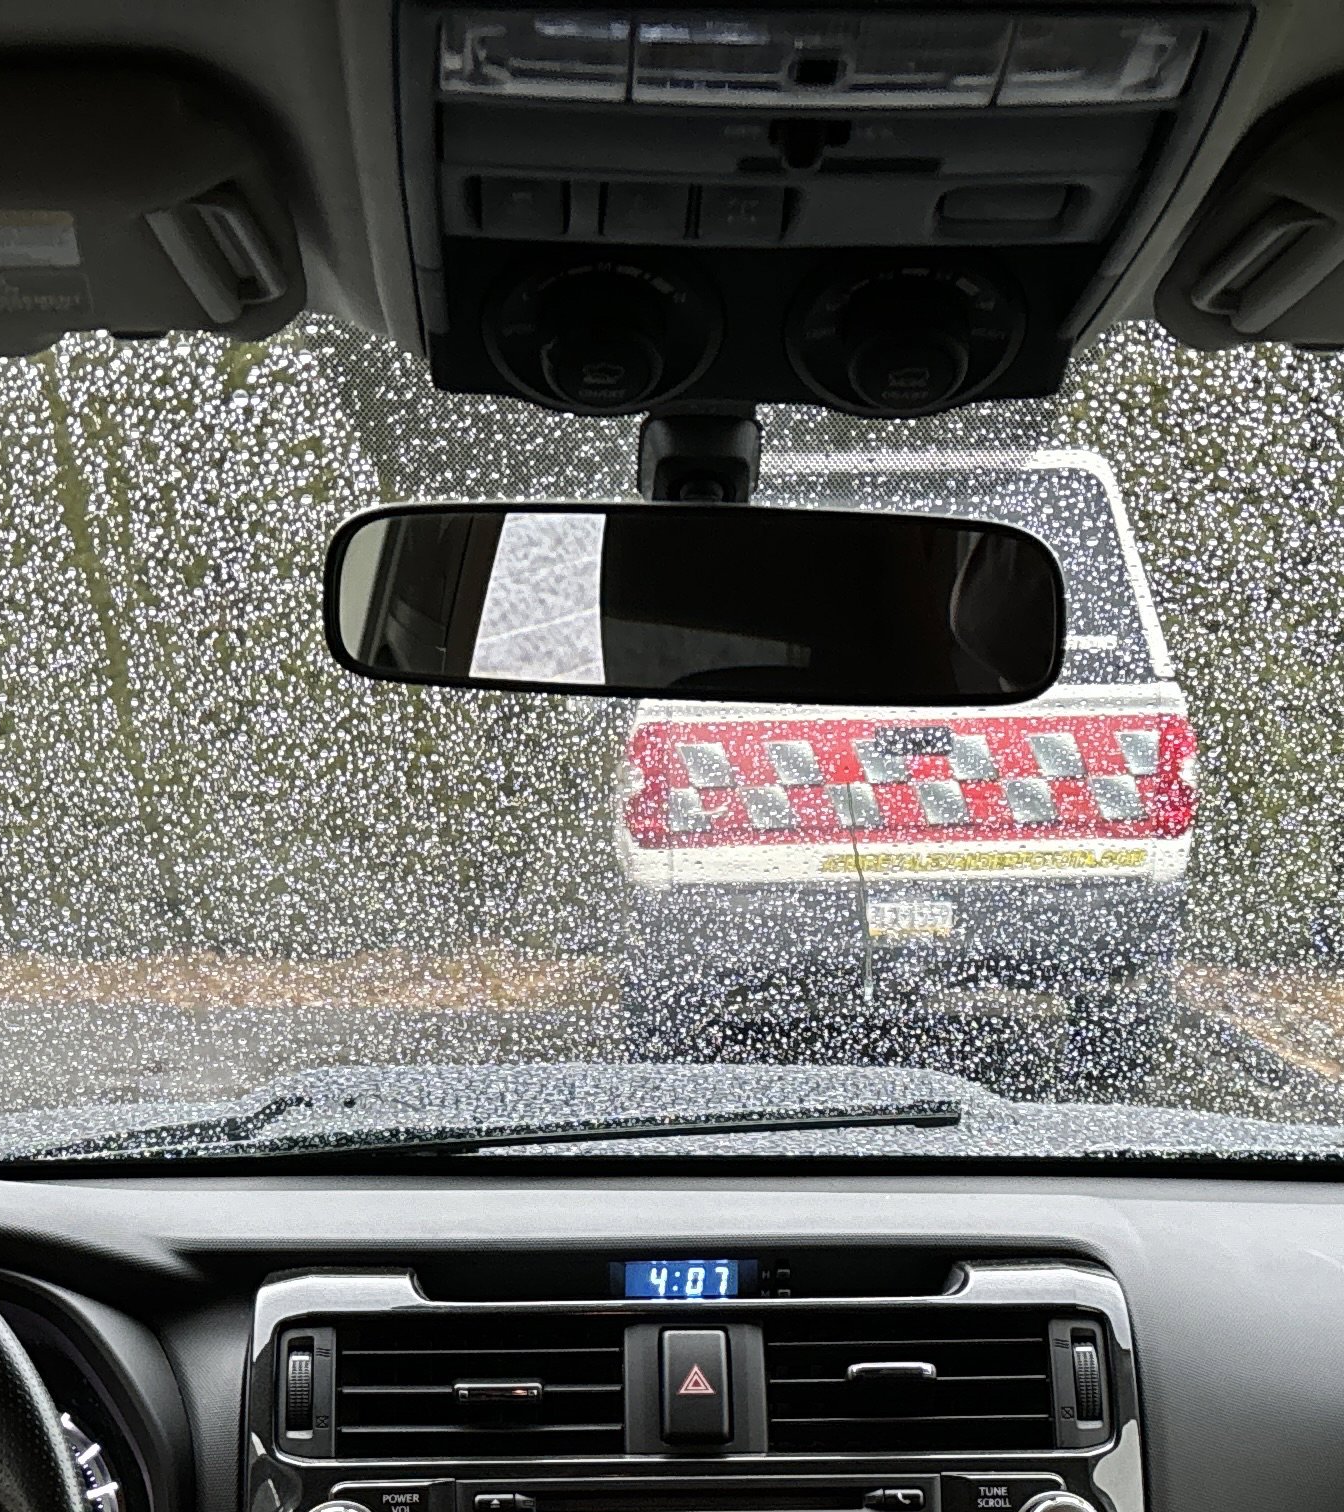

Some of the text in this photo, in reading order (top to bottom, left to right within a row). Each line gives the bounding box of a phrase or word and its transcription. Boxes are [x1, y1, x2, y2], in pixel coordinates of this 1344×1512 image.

[649, 1266, 730, 1296] 4:07
[978, 1486, 1008, 1497] TUNE
[382, 1493, 420, 1504] POWER
[977, 1498, 1012, 1508] SCROLL
